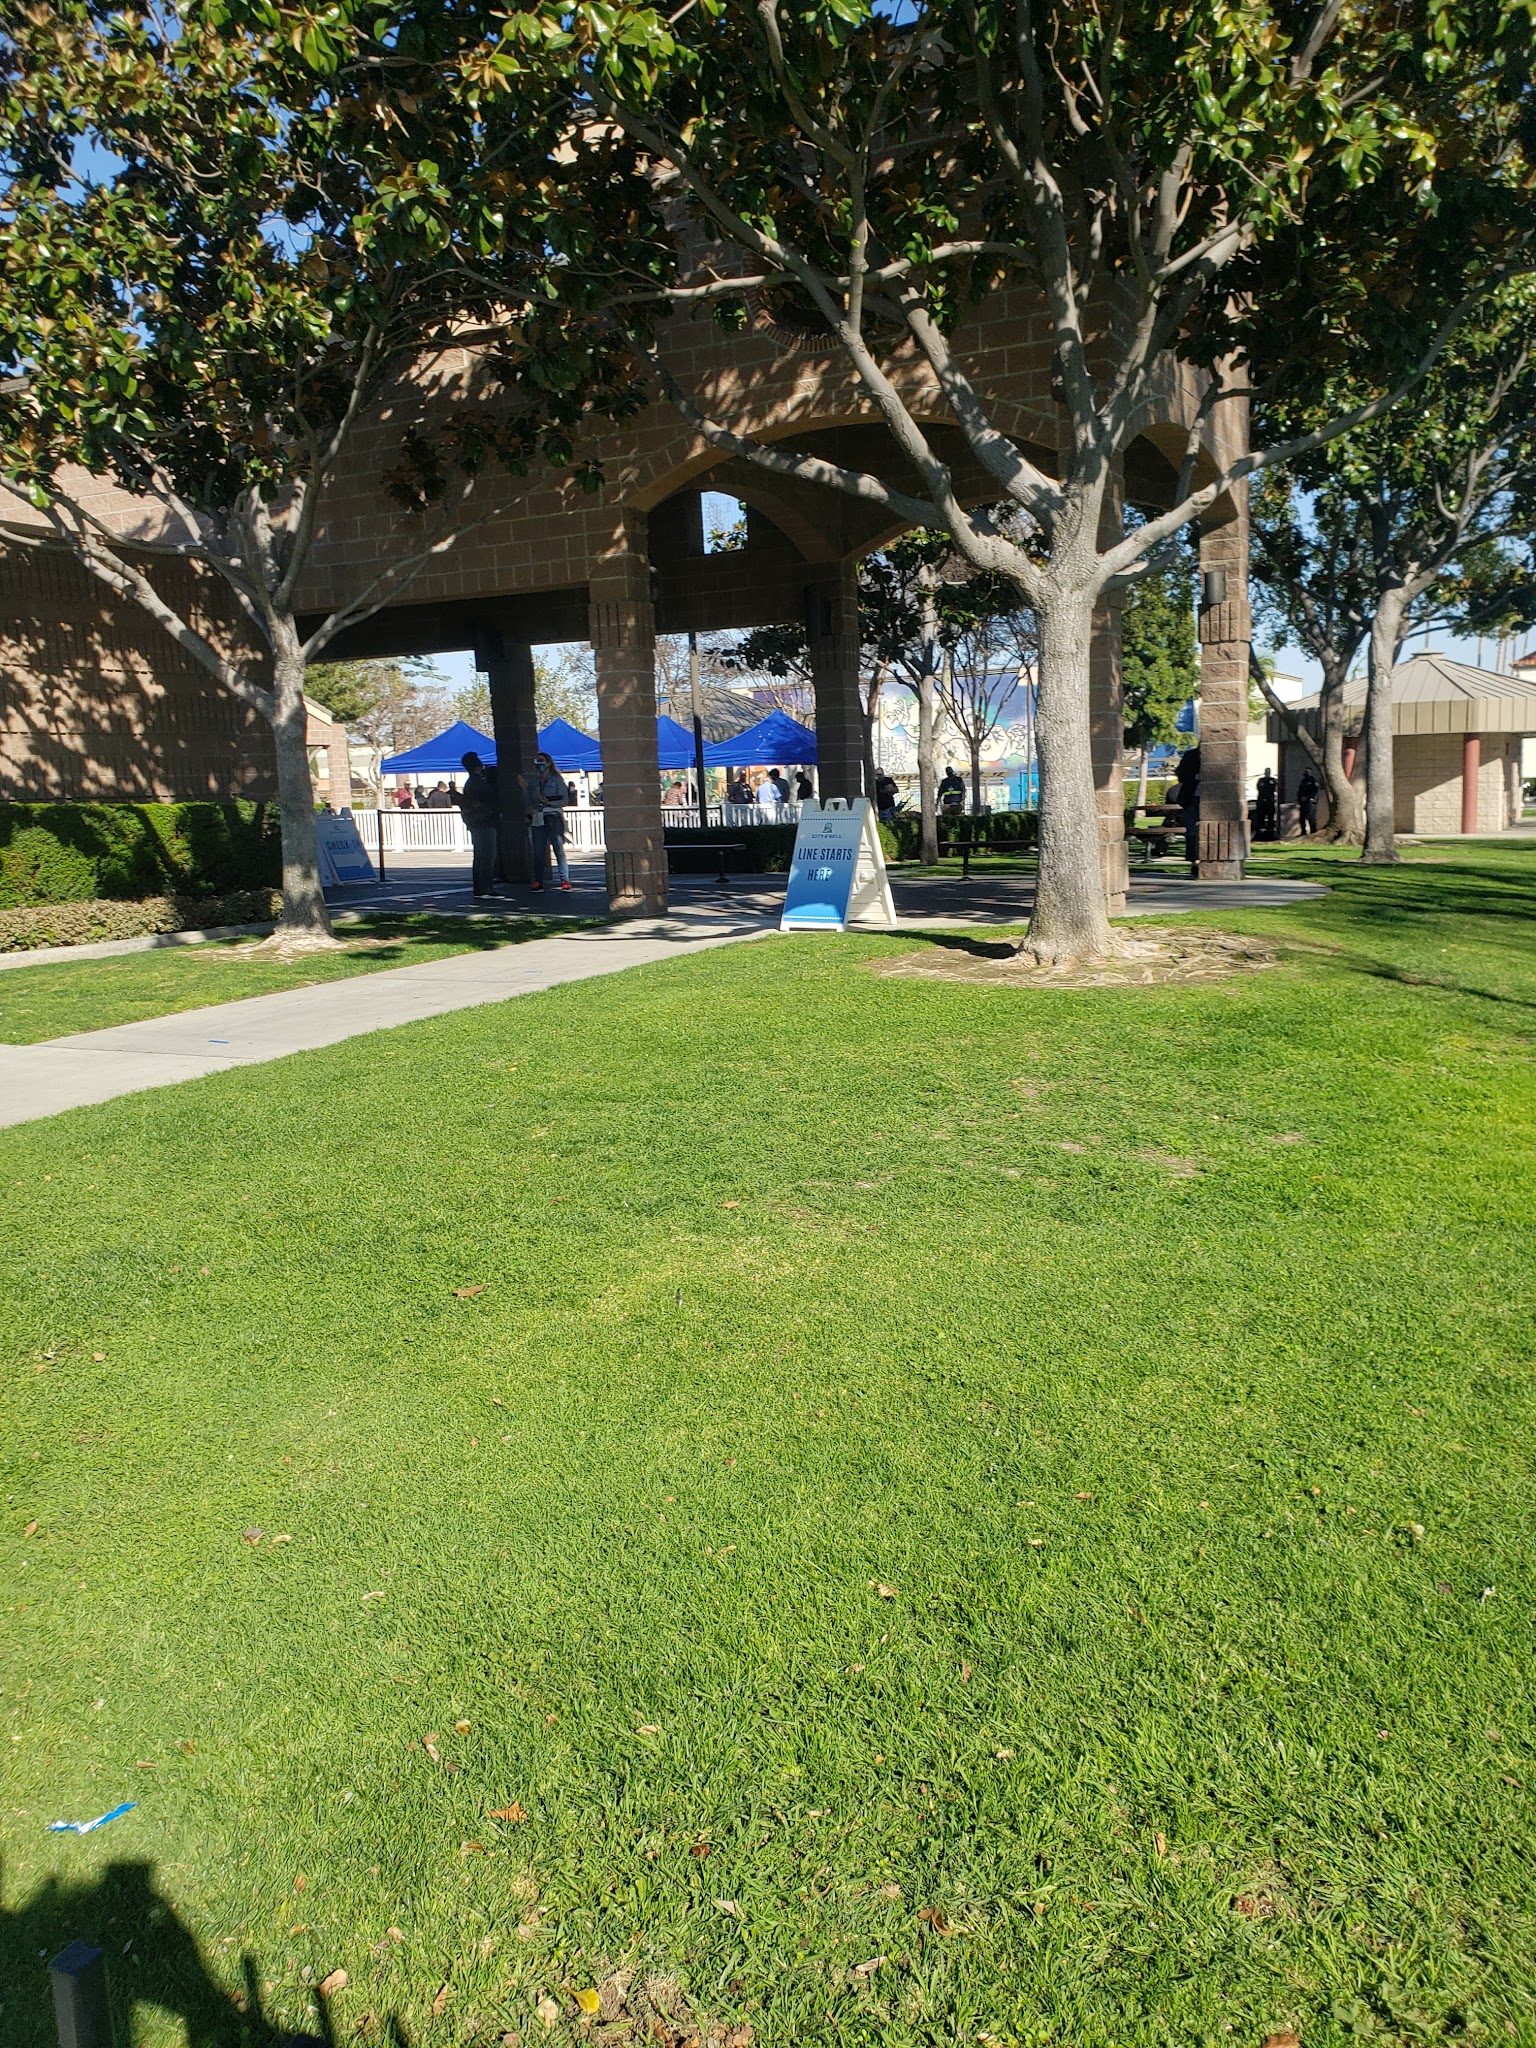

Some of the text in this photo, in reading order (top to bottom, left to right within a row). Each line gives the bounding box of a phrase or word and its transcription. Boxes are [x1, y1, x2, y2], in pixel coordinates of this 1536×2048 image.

[798, 848, 852, 860] LINE STARTS
[807, 869, 831, 881] HERE
